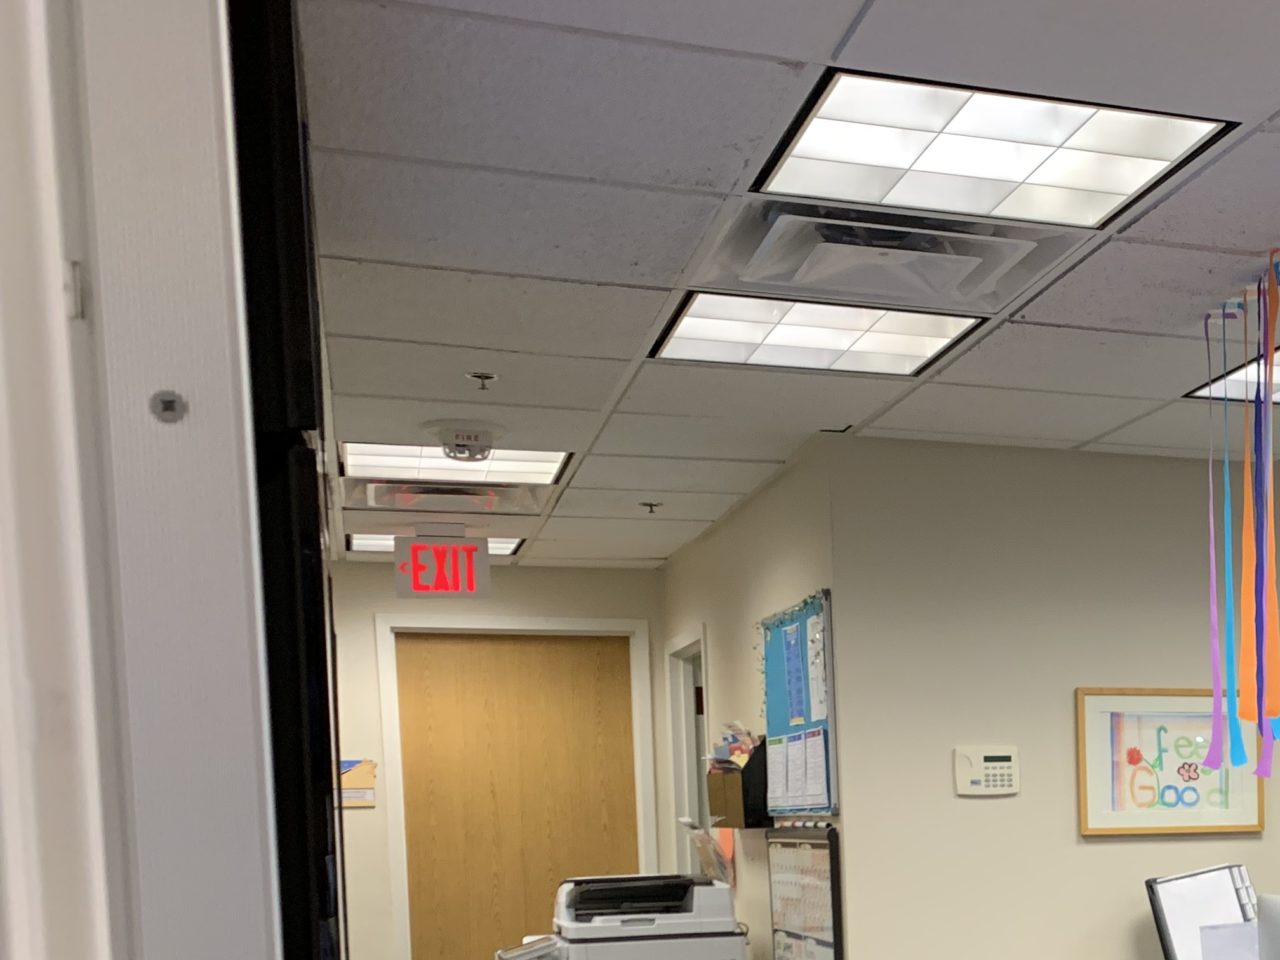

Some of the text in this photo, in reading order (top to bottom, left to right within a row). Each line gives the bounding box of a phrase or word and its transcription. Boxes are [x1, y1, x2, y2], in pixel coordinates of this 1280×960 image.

[454, 433, 481, 443] FIRE
[410, 543, 479, 593] EXIT
[1156, 724, 1209, 772] fee
[1129, 765, 1229, 810] Good
